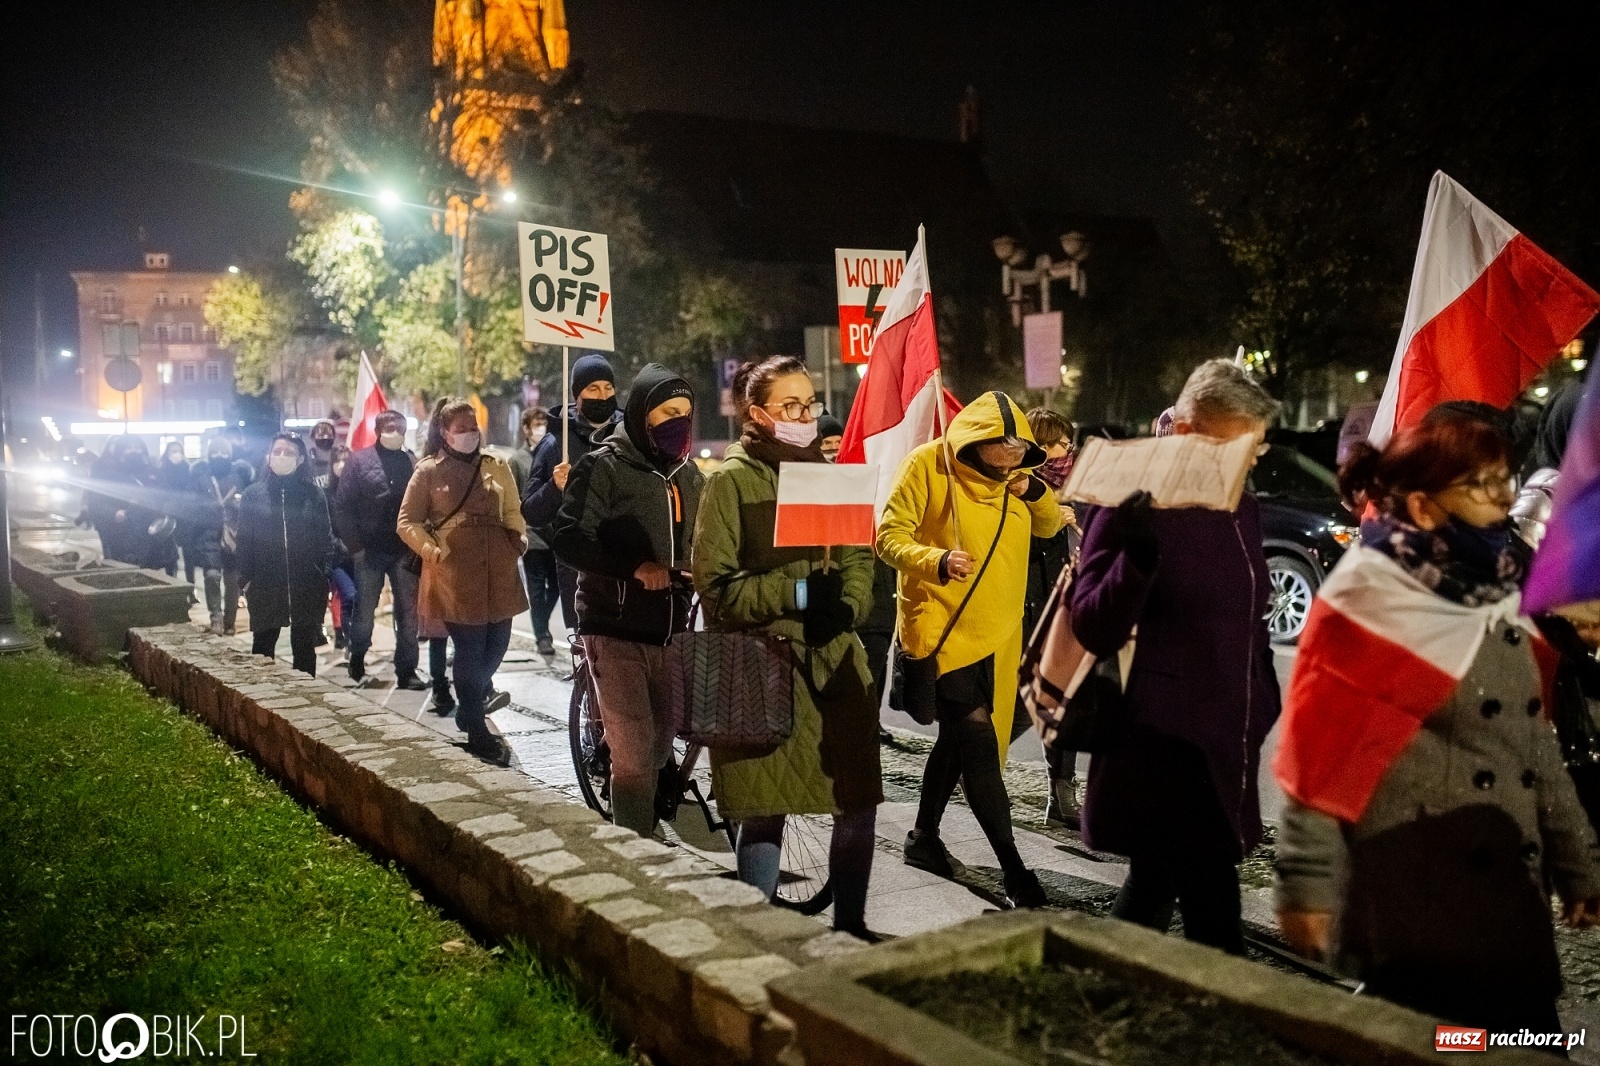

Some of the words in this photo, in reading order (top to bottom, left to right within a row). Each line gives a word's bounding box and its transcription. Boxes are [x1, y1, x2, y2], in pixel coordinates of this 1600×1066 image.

[528, 229, 595, 276] PIS
[844, 258, 904, 288] WOLNA
[529, 273, 609, 323] OFF!
[849, 324, 876, 356] PO
